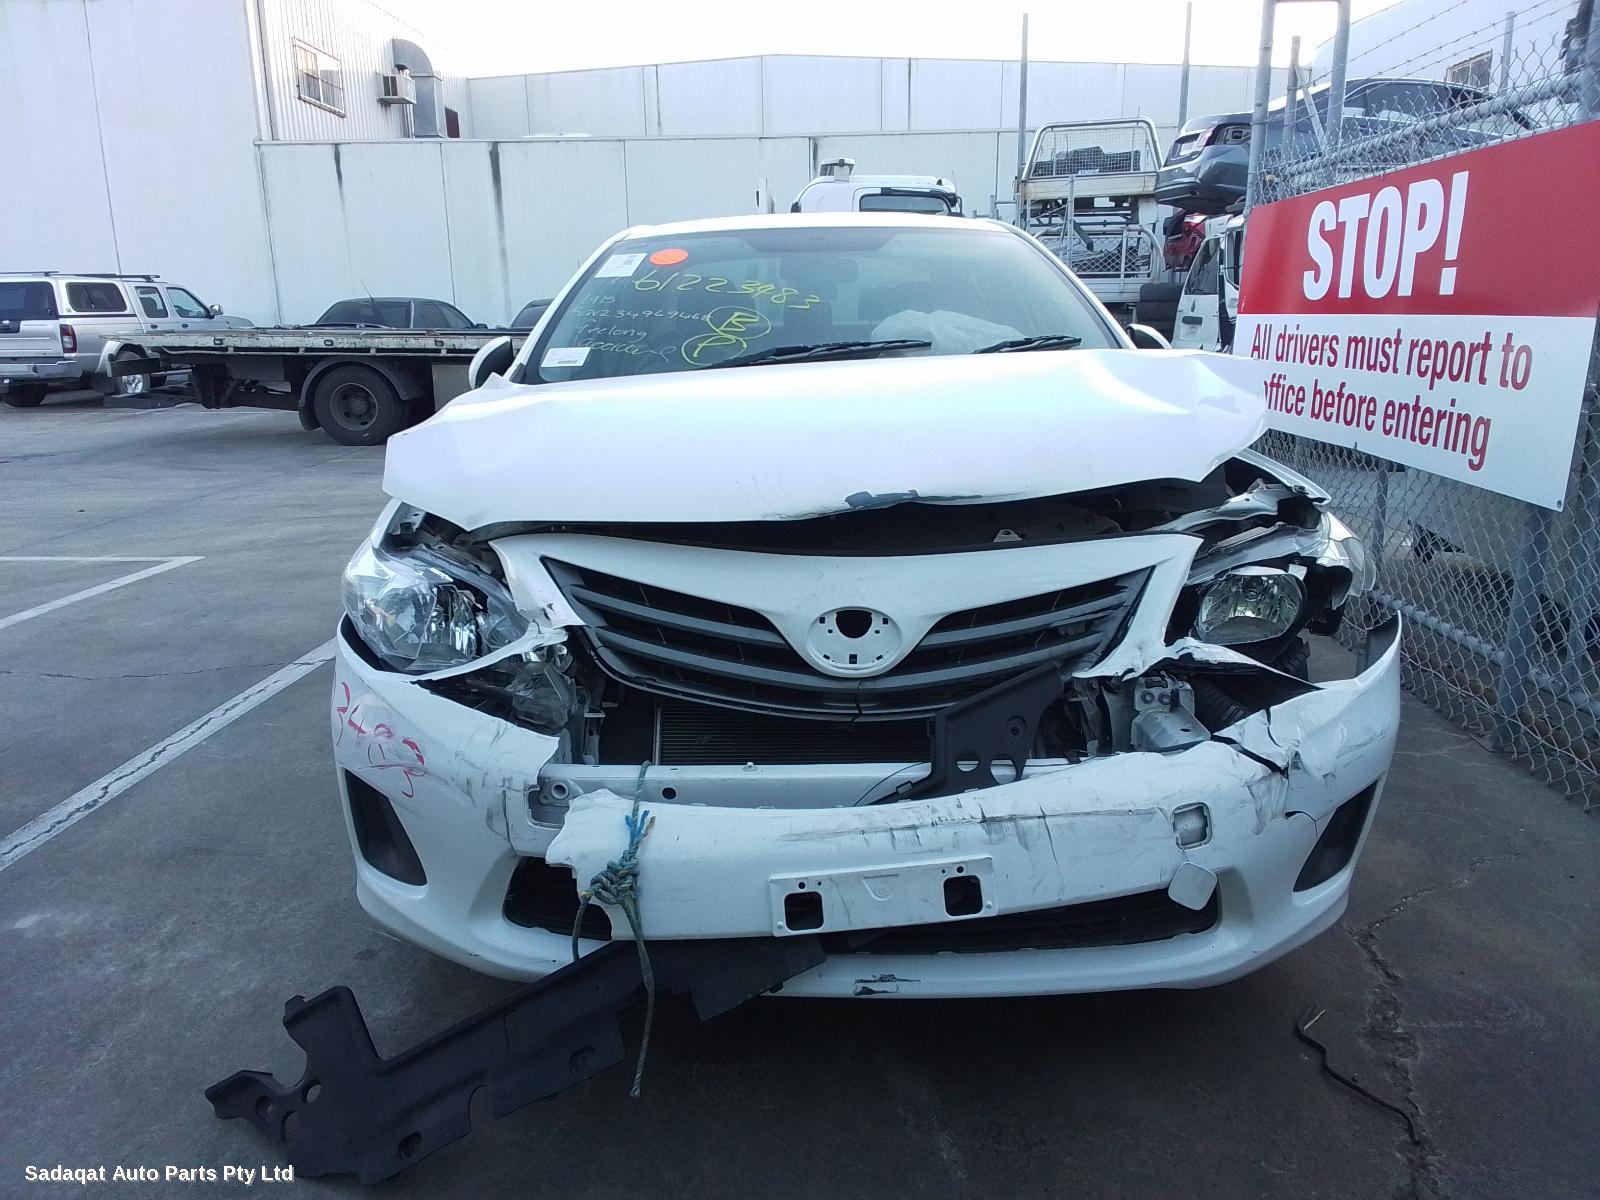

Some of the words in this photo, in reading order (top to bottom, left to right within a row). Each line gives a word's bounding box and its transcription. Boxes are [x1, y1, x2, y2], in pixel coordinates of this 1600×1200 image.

[1303, 171, 1469, 300] STOP!
[1251, 324, 1271, 361] All
[1275, 324, 1338, 368] drivers
[1344, 328, 1402, 374] must
[1406, 331, 1492, 390] report
[1499, 332, 1533, 391] to
[1310, 379, 1377, 431] before
[1382, 398, 1492, 472] entering
